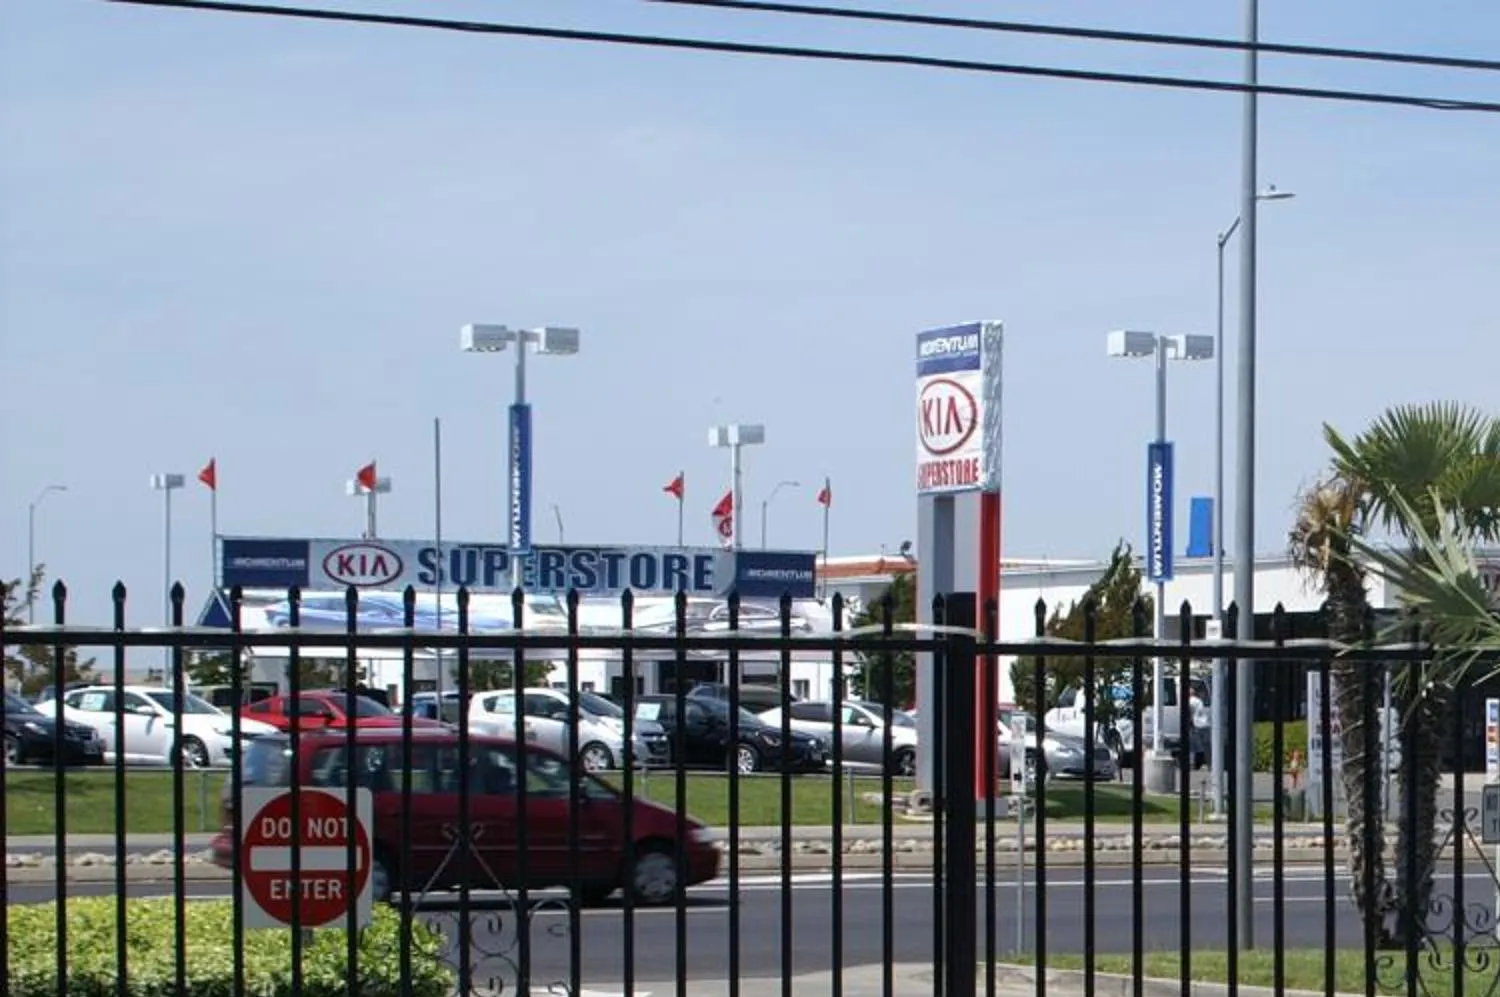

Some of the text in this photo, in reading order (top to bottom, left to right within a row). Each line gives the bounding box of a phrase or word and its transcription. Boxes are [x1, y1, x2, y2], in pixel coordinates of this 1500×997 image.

[922, 396, 963, 437] KIA
[337, 547, 713, 591] KIA SUPERSTORE
[261, 817, 292, 838] DO
